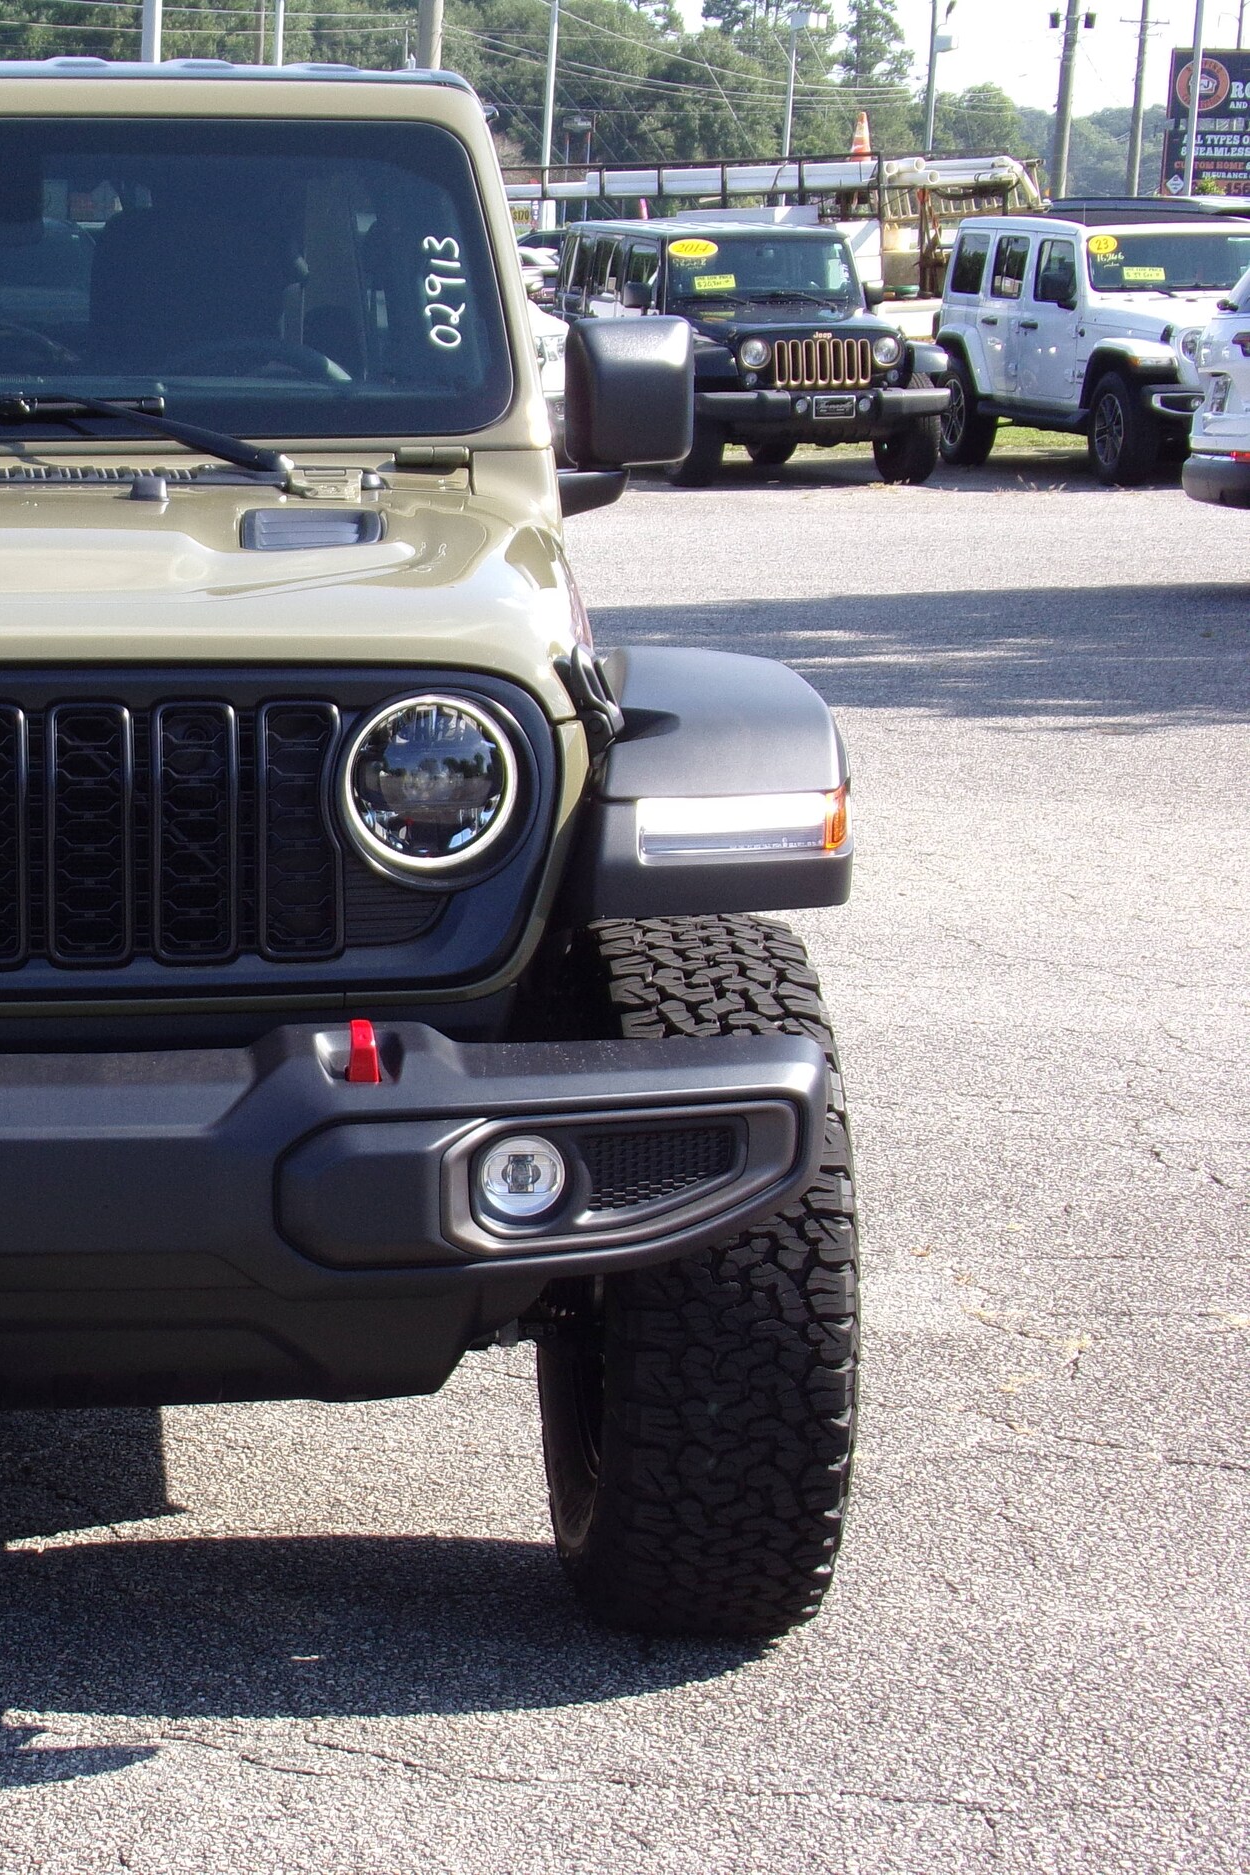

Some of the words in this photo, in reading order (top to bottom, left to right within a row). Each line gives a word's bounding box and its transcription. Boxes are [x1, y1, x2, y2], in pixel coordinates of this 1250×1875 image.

[1182, 134, 1204, 144] AL
[1206, 134, 1240, 144] TYPES
[1174, 161, 1215, 170] CUTOM
[1216, 161, 1245, 170] HOME
[1202, 171, 1248, 179] INSURANCE
[513, 210, 530, 220] $170
[676, 243, 710, 253] 2014
[1095, 238, 1109, 250] 23
[813, 331, 832, 339] Jeep
